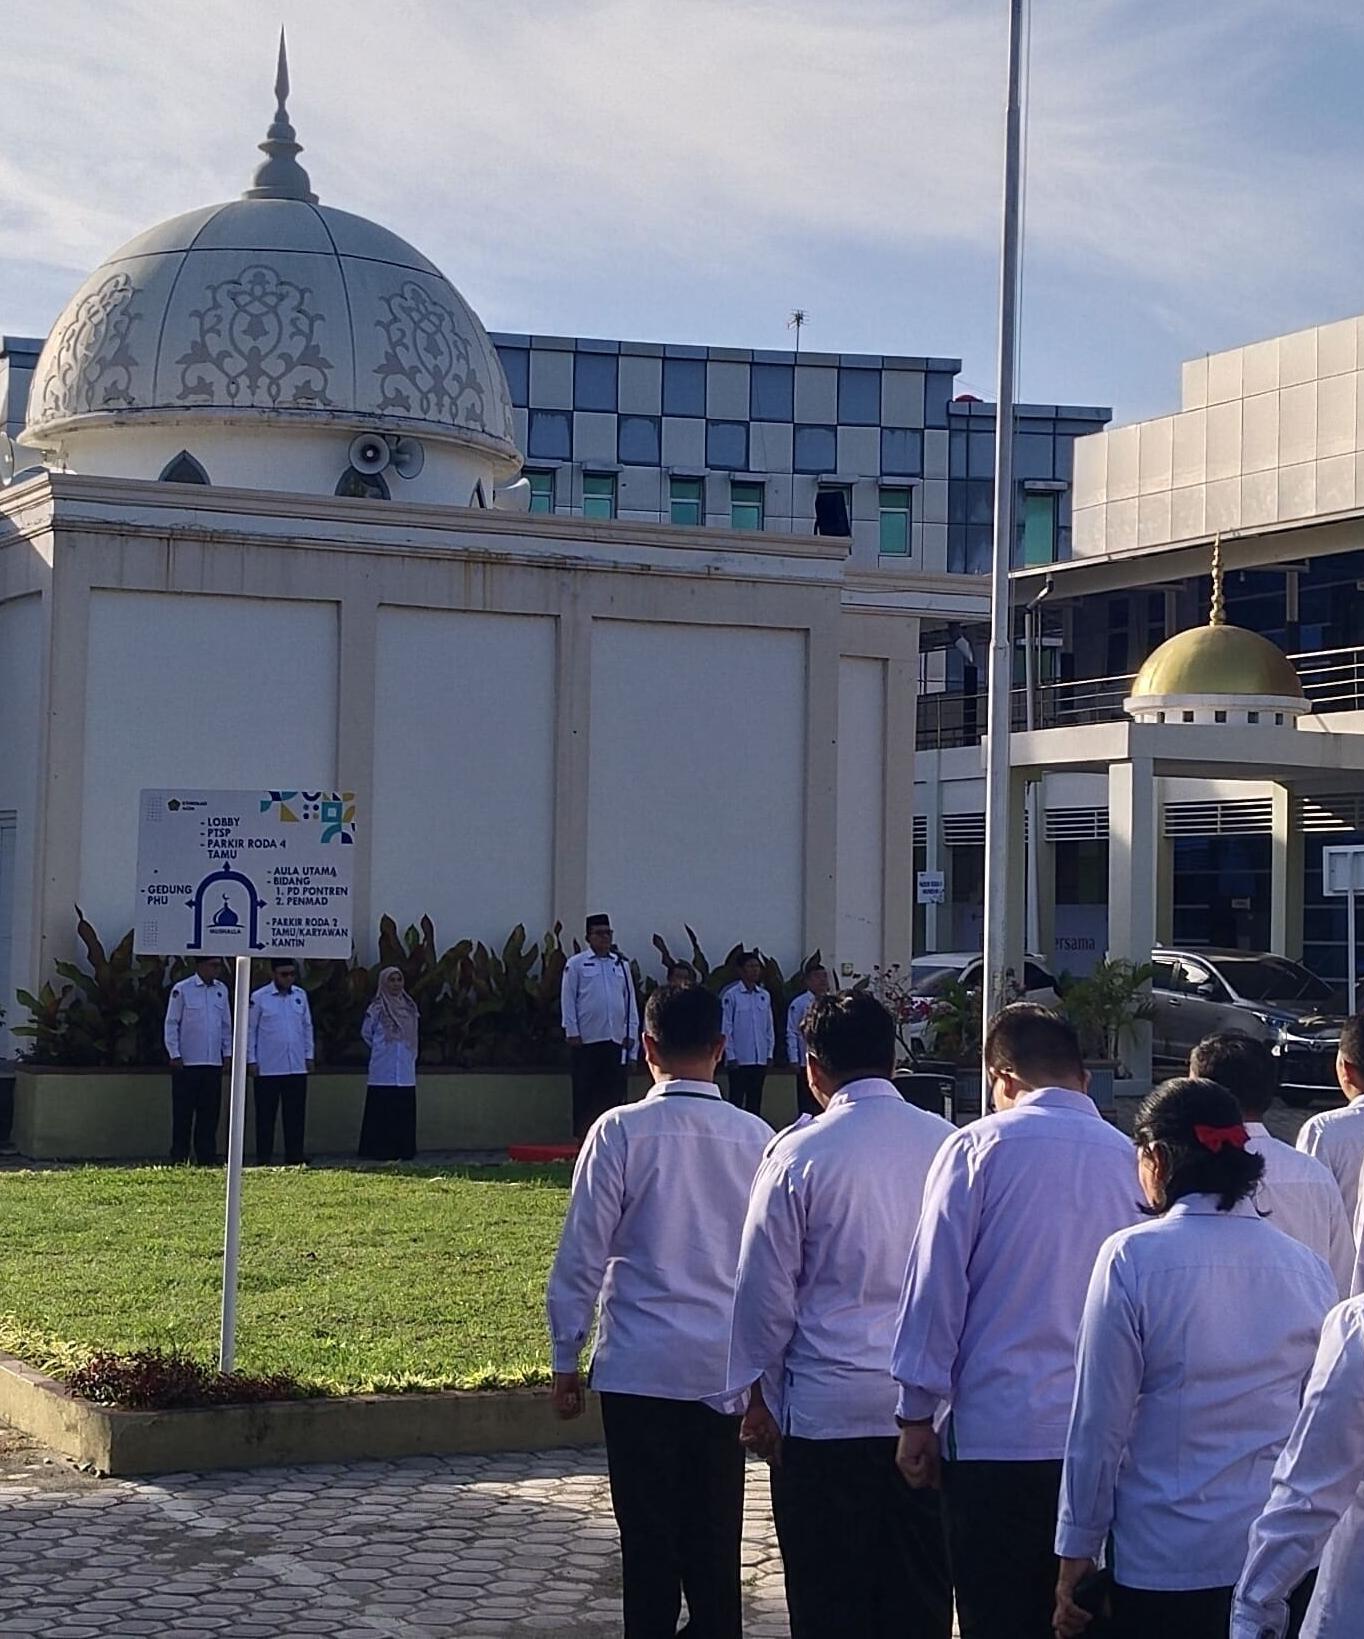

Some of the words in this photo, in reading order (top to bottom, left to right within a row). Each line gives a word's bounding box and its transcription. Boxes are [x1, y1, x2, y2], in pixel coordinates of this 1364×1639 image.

[207, 817, 240, 827] LOBBY
[207, 828, 231, 838] PTSP
[207, 839, 244, 849] PARKIR
[248, 839, 277, 849] RODA
[280, 839, 286, 849] 4
[207, 850, 237, 859] TAMU
[273, 866, 299, 876] AULA
[302, 866, 337, 877] UTAMA
[273, 877, 310, 886] BIDANG
[147, 885, 192, 895] GEDUNG
[276, 887, 285, 896] 1.
[287, 887, 299, 896] PD
[301, 887, 348, 897] PONTREN
[147, 896, 169, 905] PHU
[275, 897, 285, 906] 2.
[286, 897, 328, 906] PENMAD
[271, 918, 302, 927] PARKIR
[304, 918, 331, 927] RODA
[332, 918, 338, 927] 2
[271, 928, 348, 938] TAMU/KARYAWAN
[271, 938, 305, 948] KANTIN
